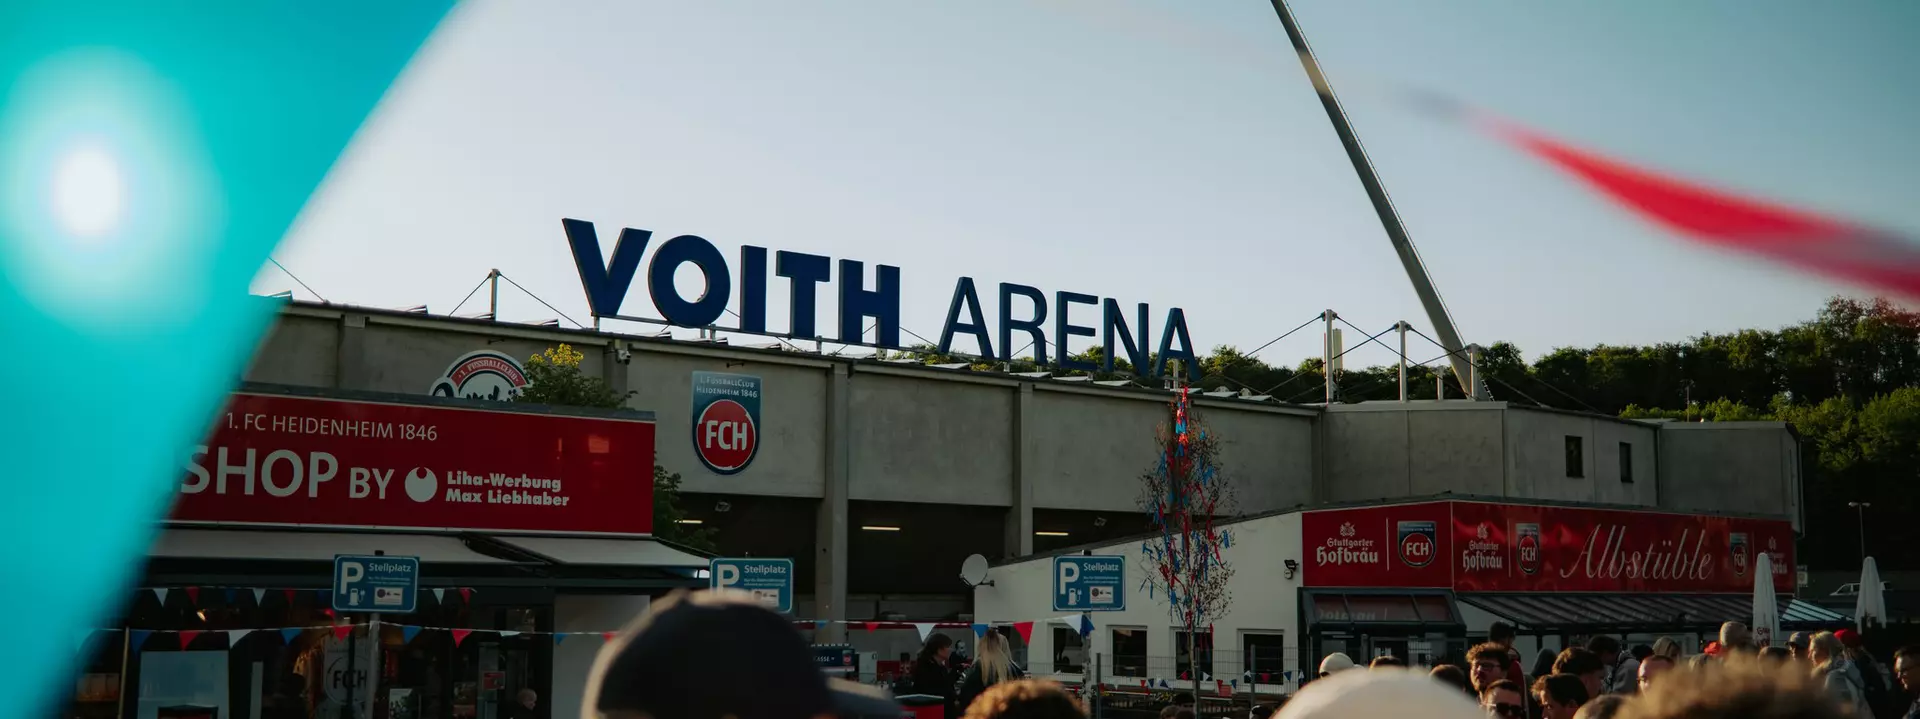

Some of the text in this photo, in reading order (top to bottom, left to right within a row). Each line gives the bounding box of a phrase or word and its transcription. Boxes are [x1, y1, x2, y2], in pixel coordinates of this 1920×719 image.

[562, 217, 1200, 381] VOITH ARENA
[696, 386, 758, 398] HEIDENHEIM 1846
[227, 412, 437, 441] 1. FC HEIDENHEIM 1846
[706, 420, 747, 450] FCH
[181, 445, 394, 499] SHOP BY
[447, 471, 561, 493] Liha-Werbung
[446, 488, 569, 506] Max Liebhaber
[1327, 537, 1374, 549] Stuttgarter
[1406, 542, 1429, 556] FCH
[1521, 547, 1536, 561] FCH
[1560, 523, 1714, 580] Albstüble
[1316, 545, 1378, 567] Hofbräu
[1462, 550, 1502, 572] Hofbräu
[340, 562, 364, 595] P
[368, 562, 411, 574] Stellplatz
[717, 564, 740, 593] P
[743, 565, 786, 575] Stellplatz
[1060, 562, 1080, 595] P
[1083, 562, 1119, 573] Stellplatz
